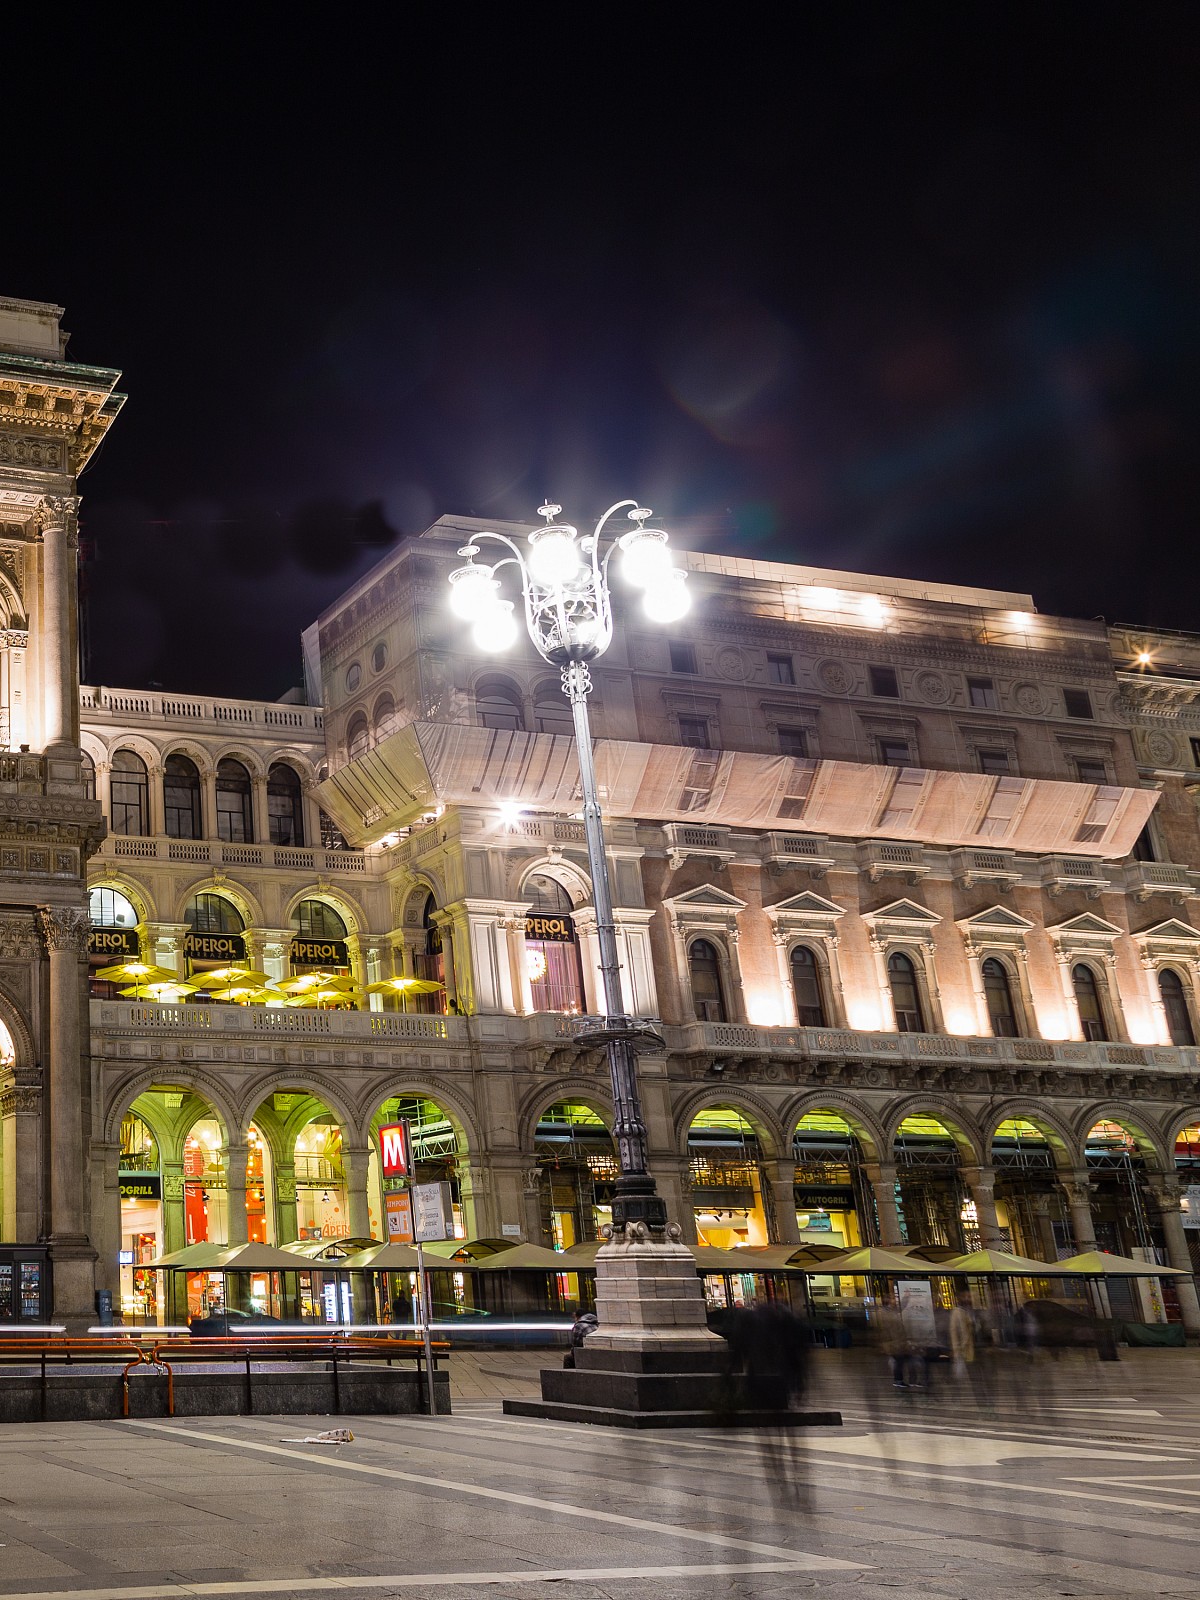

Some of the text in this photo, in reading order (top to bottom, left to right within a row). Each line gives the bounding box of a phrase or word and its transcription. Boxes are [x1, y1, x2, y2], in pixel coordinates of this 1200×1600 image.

[526, 918, 569, 935] PEROL
[87, 932, 130, 949] PEROL
[183, 934, 237, 954] APEROL
[290, 940, 340, 960] APEROL
[383, 1133, 405, 1168] M
[806, 1196, 848, 1204] AUTOGRILL
